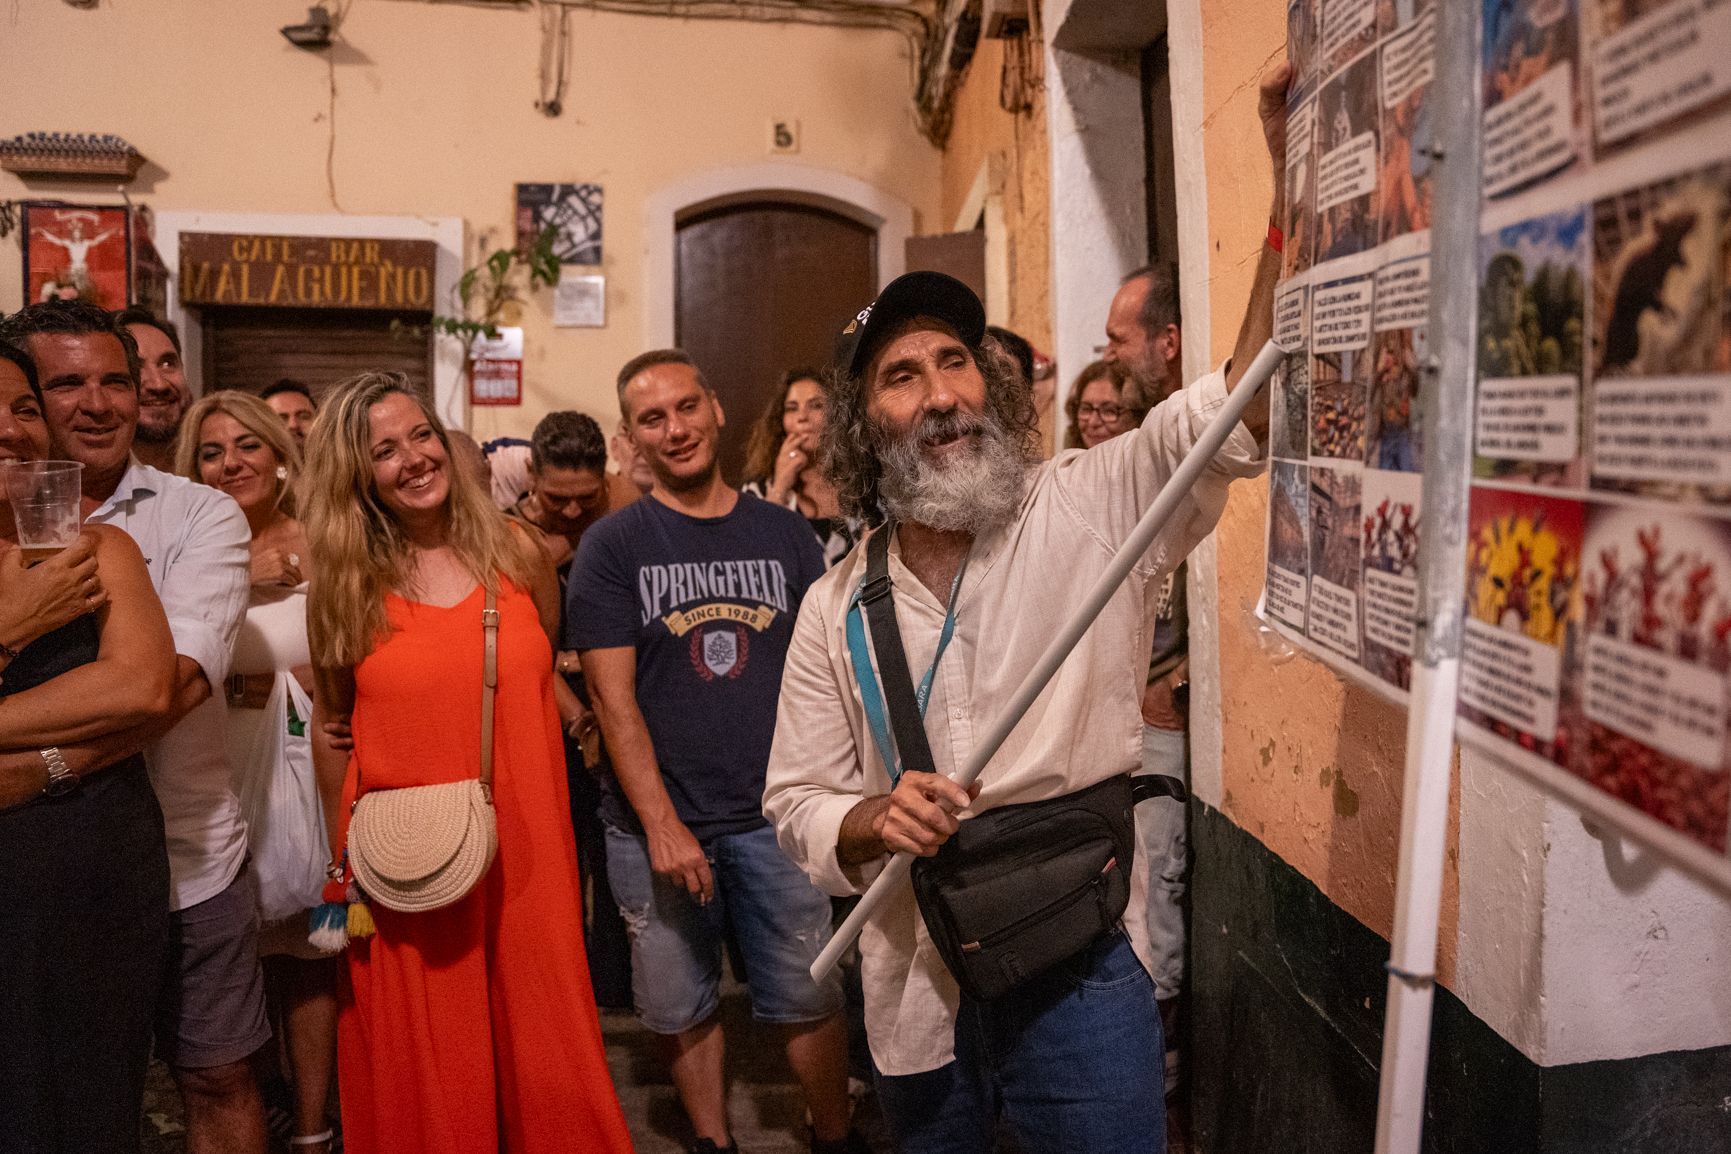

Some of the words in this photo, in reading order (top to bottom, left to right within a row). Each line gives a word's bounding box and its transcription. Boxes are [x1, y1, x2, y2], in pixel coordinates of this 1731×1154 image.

[774, 123, 793, 147] 5
[331, 240, 382, 264] BAR
[181, 256, 429, 307] MALAGUEÑO
[638, 558, 788, 627] SPRINGFIELD
[683, 606, 722, 626] SINCE
[727, 606, 760, 625] 1988
